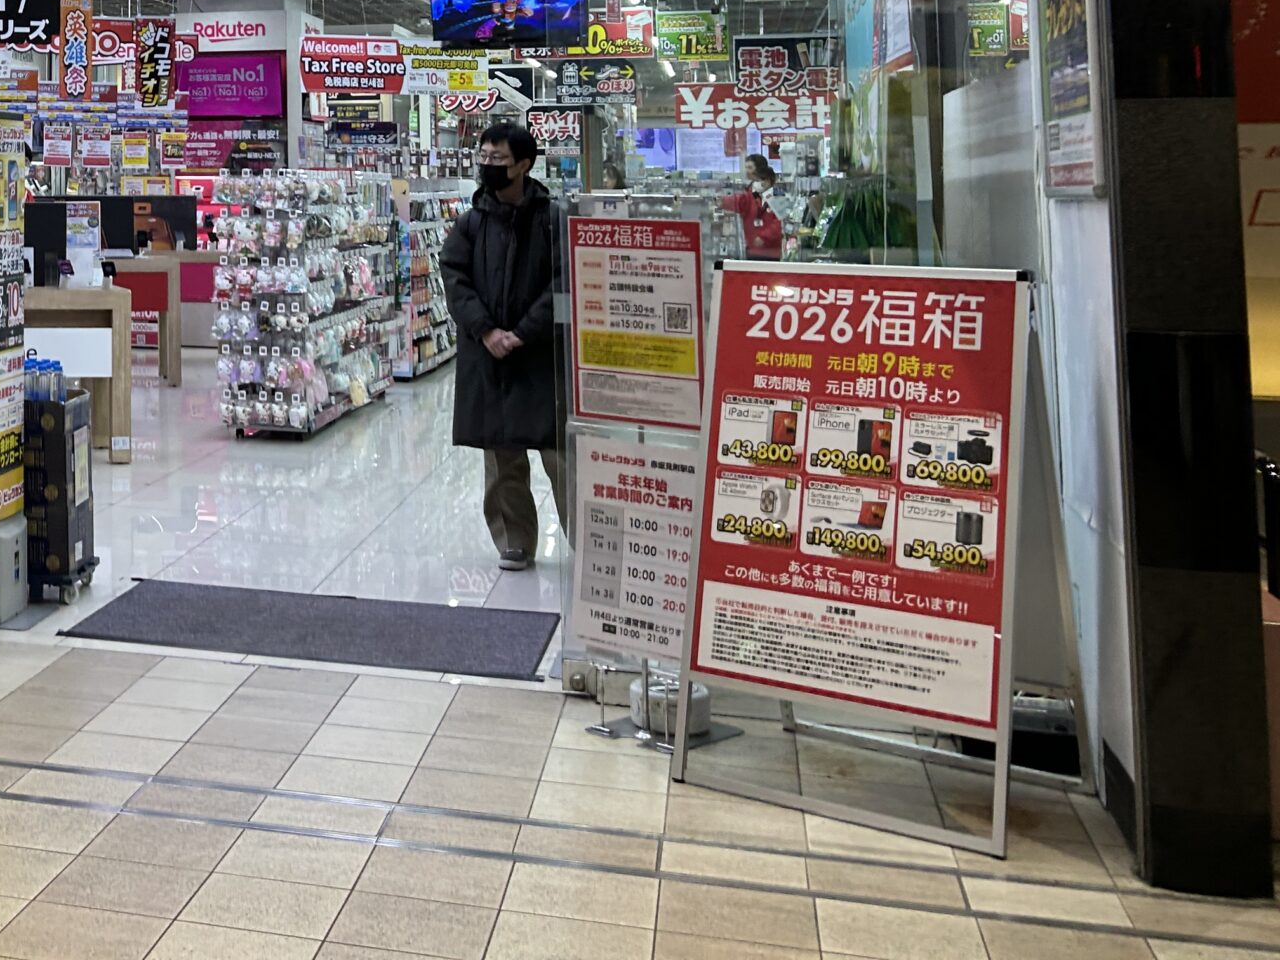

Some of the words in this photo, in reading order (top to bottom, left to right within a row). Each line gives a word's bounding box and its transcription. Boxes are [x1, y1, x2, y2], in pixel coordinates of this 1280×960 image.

[193, 22, 267, 38] Rakuten
[64, 9, 88, 96] 英雄祭
[154, 26, 172, 77] ドコモ
[303, 39, 364, 55] Welcome!!
[678, 33, 708, 55] 11%
[302, 57, 329, 74] Tax
[332, 57, 364, 74] Free
[366, 58, 406, 75] Store
[737, 46, 788, 69] 電池
[139, 46, 160, 108] イチオシ
[233, 64, 265, 82] No.1
[425, 71, 447, 87] 10%
[324, 76, 359, 88] 免税商店
[360, 77, 385, 89] 면세점
[596, 78, 635, 93] のぼり
[441, 89, 497, 110] タップ
[678, 86, 832, 130] ¥お会計
[750, 284, 854, 306] ビックカメラ
[745, 289, 986, 351] 2026福箱
[755, 350, 812, 370] 受付時間
[827, 351, 955, 381] 元日朝9時まで
[753, 373, 812, 392] 販売開始
[825, 376, 961, 406] 元日朝10時より
[726, 406, 751, 419] iPad
[816, 416, 851, 430] iPhone
[601, 454, 646, 468] ビックカメラ
[617, 472, 668, 493] 年末年始
[592, 483, 693, 512] 営業時間のご案内
[905, 504, 955, 520] プロジェクター
[629, 516, 658, 532] 10:00
[628, 541, 657, 557] 10:00
[626, 566, 656, 582] 10:00
[788, 559, 898, 589] あくまで一例です!
[723, 563, 969, 616] この他にも多数の福箱をご用意しています!!
[625, 591, 654, 607] 10:00
[825, 605, 856, 618] 注意事項
